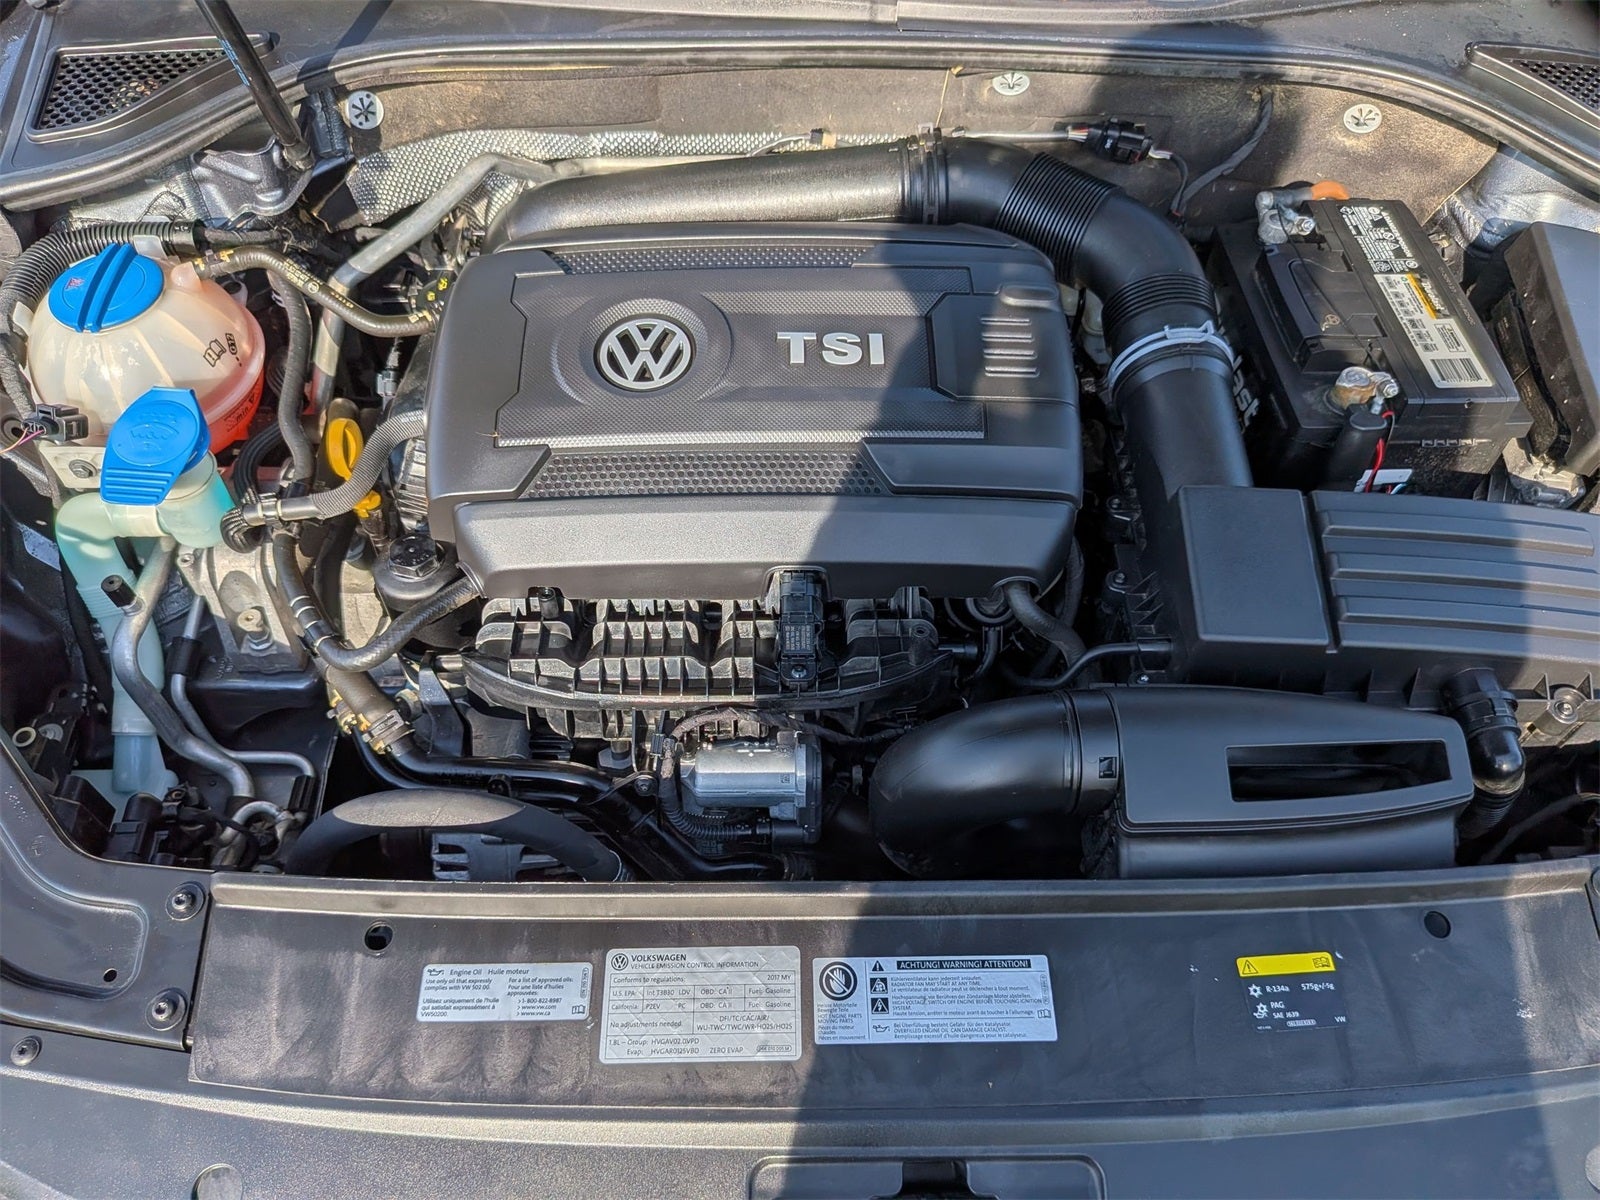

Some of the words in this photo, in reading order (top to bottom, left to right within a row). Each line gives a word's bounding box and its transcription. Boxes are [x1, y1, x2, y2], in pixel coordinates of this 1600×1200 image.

[776, 331, 885, 366] TSI
[631, 954, 687, 962] VOLKSWAGEN
[687, 961, 714, 969] CONTROL
[717, 960, 759, 968] INFORMATION
[900, 961, 941, 969] ACHTUNG!
[942, 960, 982, 968] WARNING!
[983, 960, 1028, 968] ATTENTION!
[450, 969, 472, 977] Engine
[1266, 985, 1290, 993] R-134a
[1270, 1001, 1285, 1009] PAG
[620, 1021, 657, 1029] adjustments
